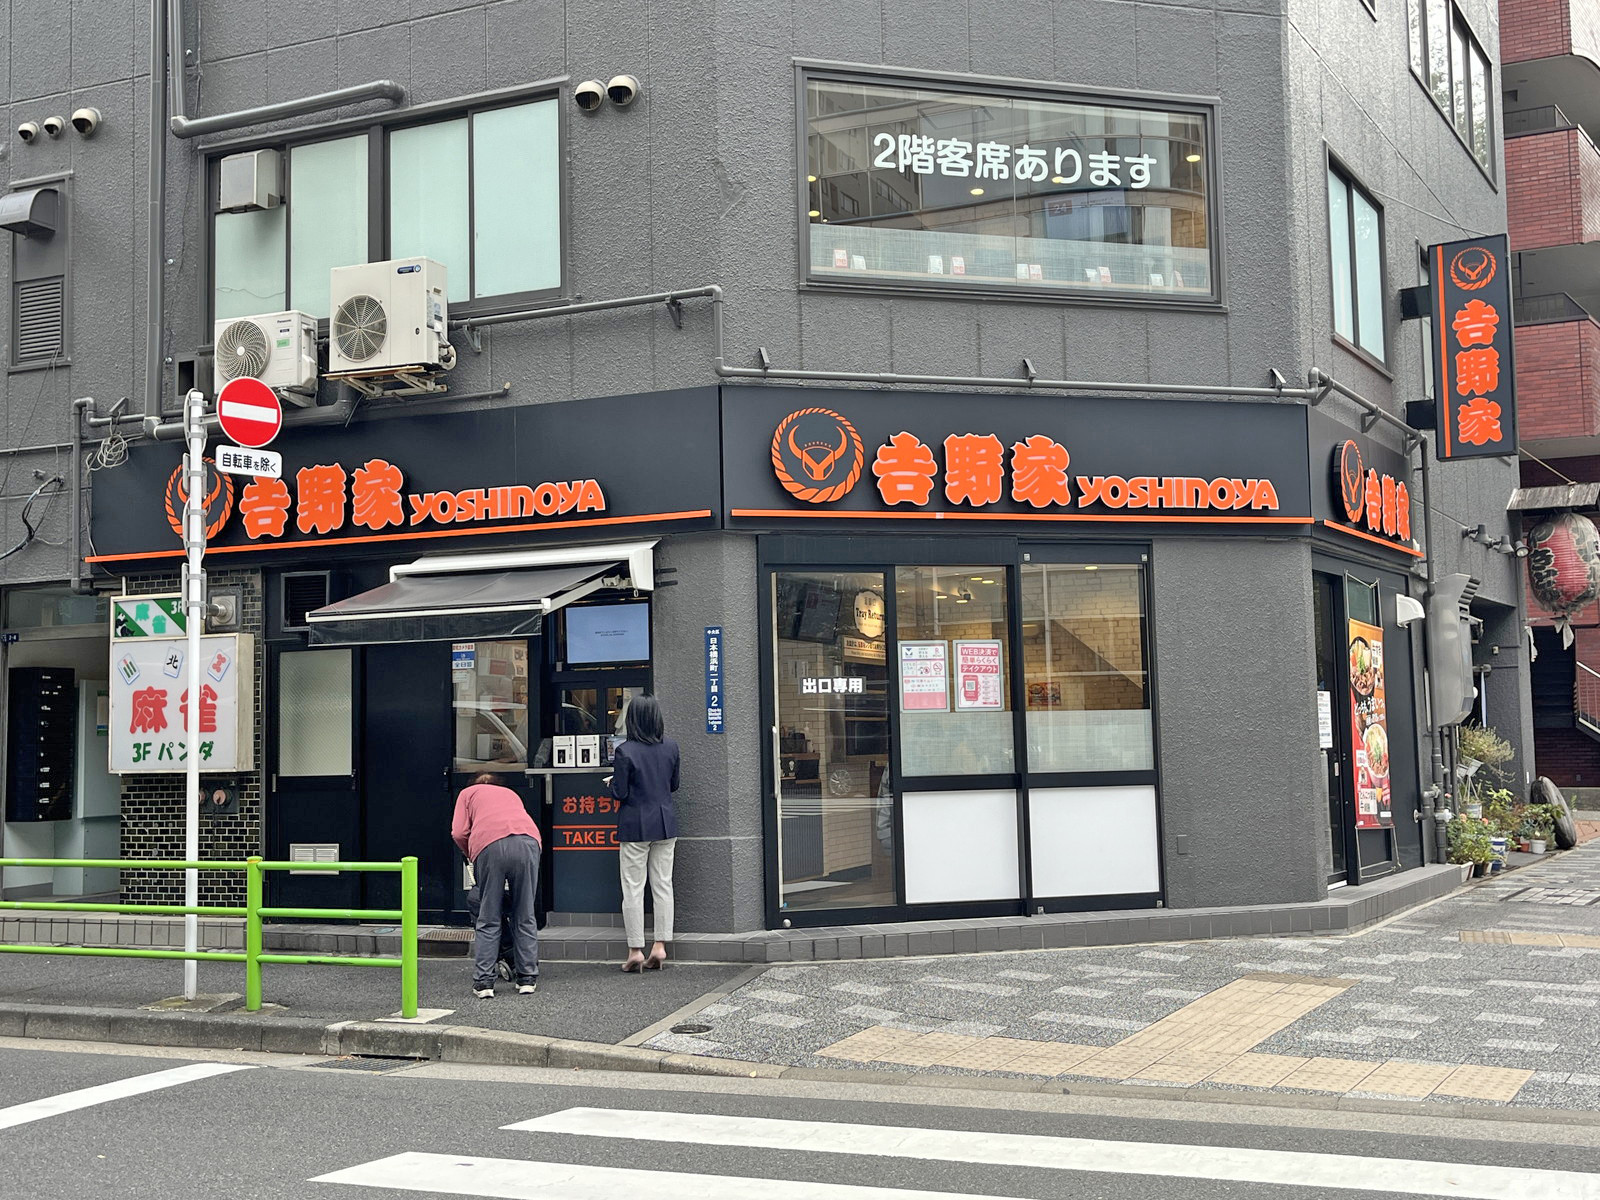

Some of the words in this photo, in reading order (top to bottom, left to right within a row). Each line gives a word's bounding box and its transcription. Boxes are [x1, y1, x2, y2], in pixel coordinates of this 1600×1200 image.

[873, 132, 1157, 189] 2階客席あります
[222, 452, 276, 473] 自転車を除く
[409, 479, 606, 525] YOSHINOYA
[1074, 476, 1280, 511] YOSHINOYA
[962, 665, 998, 673] テイクアウト
[802, 677, 863, 694] 出口専用
[130, 684, 218, 735] 麻雀
[563, 832, 605, 844] TAKE
